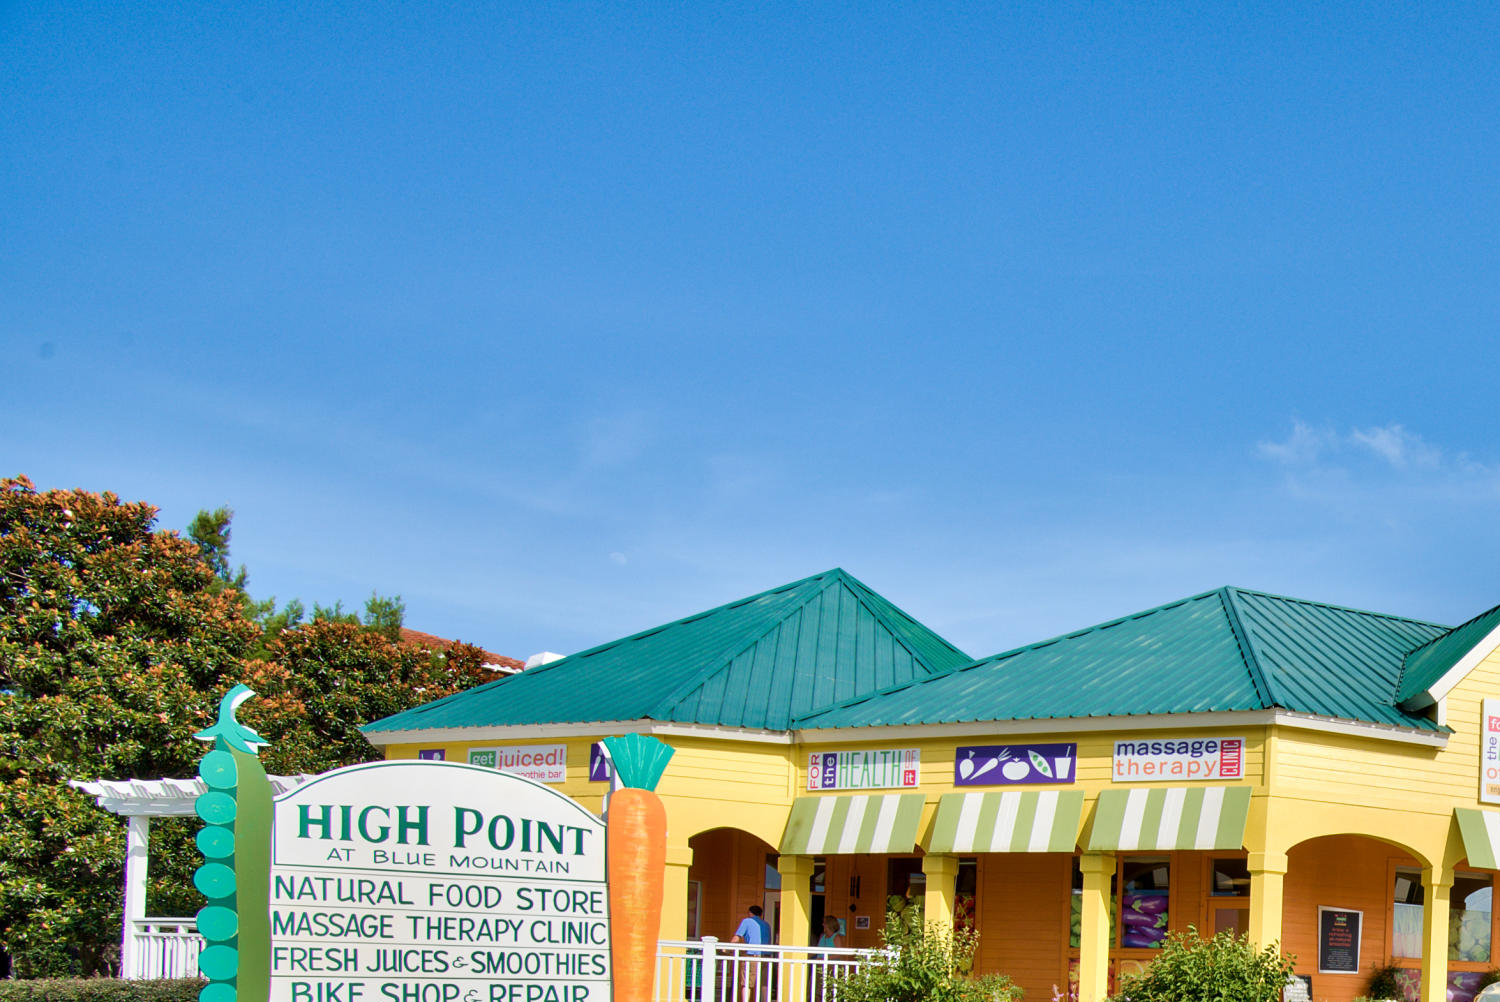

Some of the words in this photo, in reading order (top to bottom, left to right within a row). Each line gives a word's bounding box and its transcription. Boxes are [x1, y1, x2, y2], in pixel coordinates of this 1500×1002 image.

[471, 752, 494, 765] get
[497, 748, 564, 770] juiced!
[905, 750, 917, 768] OF
[1117, 739, 1218, 758] massage
[1221, 741, 1240, 775] CLINIC
[1487, 736, 1497, 760] the
[548, 770, 562, 779] bar
[810, 754, 820, 789] FOR
[824, 756, 836, 786] the
[839, 750, 901, 788] HEALTH
[905, 772, 914, 784] it
[1115, 758, 1217, 778] therapy
[297, 804, 433, 846] HIGH
[453, 805, 593, 856] POINT
[326, 848, 356, 862] AT
[373, 849, 436, 867] BLUE
[450, 854, 569, 874] MOUNTAIN
[275, 875, 415, 906] NATURAL
[429, 883, 502, 909] FOOD
[516, 887, 603, 915] STORE
[273, 910, 394, 939] MASSAGE
[406, 914, 524, 943] THERAPY
[530, 920, 606, 945] CLINIC
[273, 946, 359, 972] FRESH
[366, 948, 449, 973] JUICES
[452, 956, 469, 968] &
[471, 950, 606, 976] SMOOTHIES
